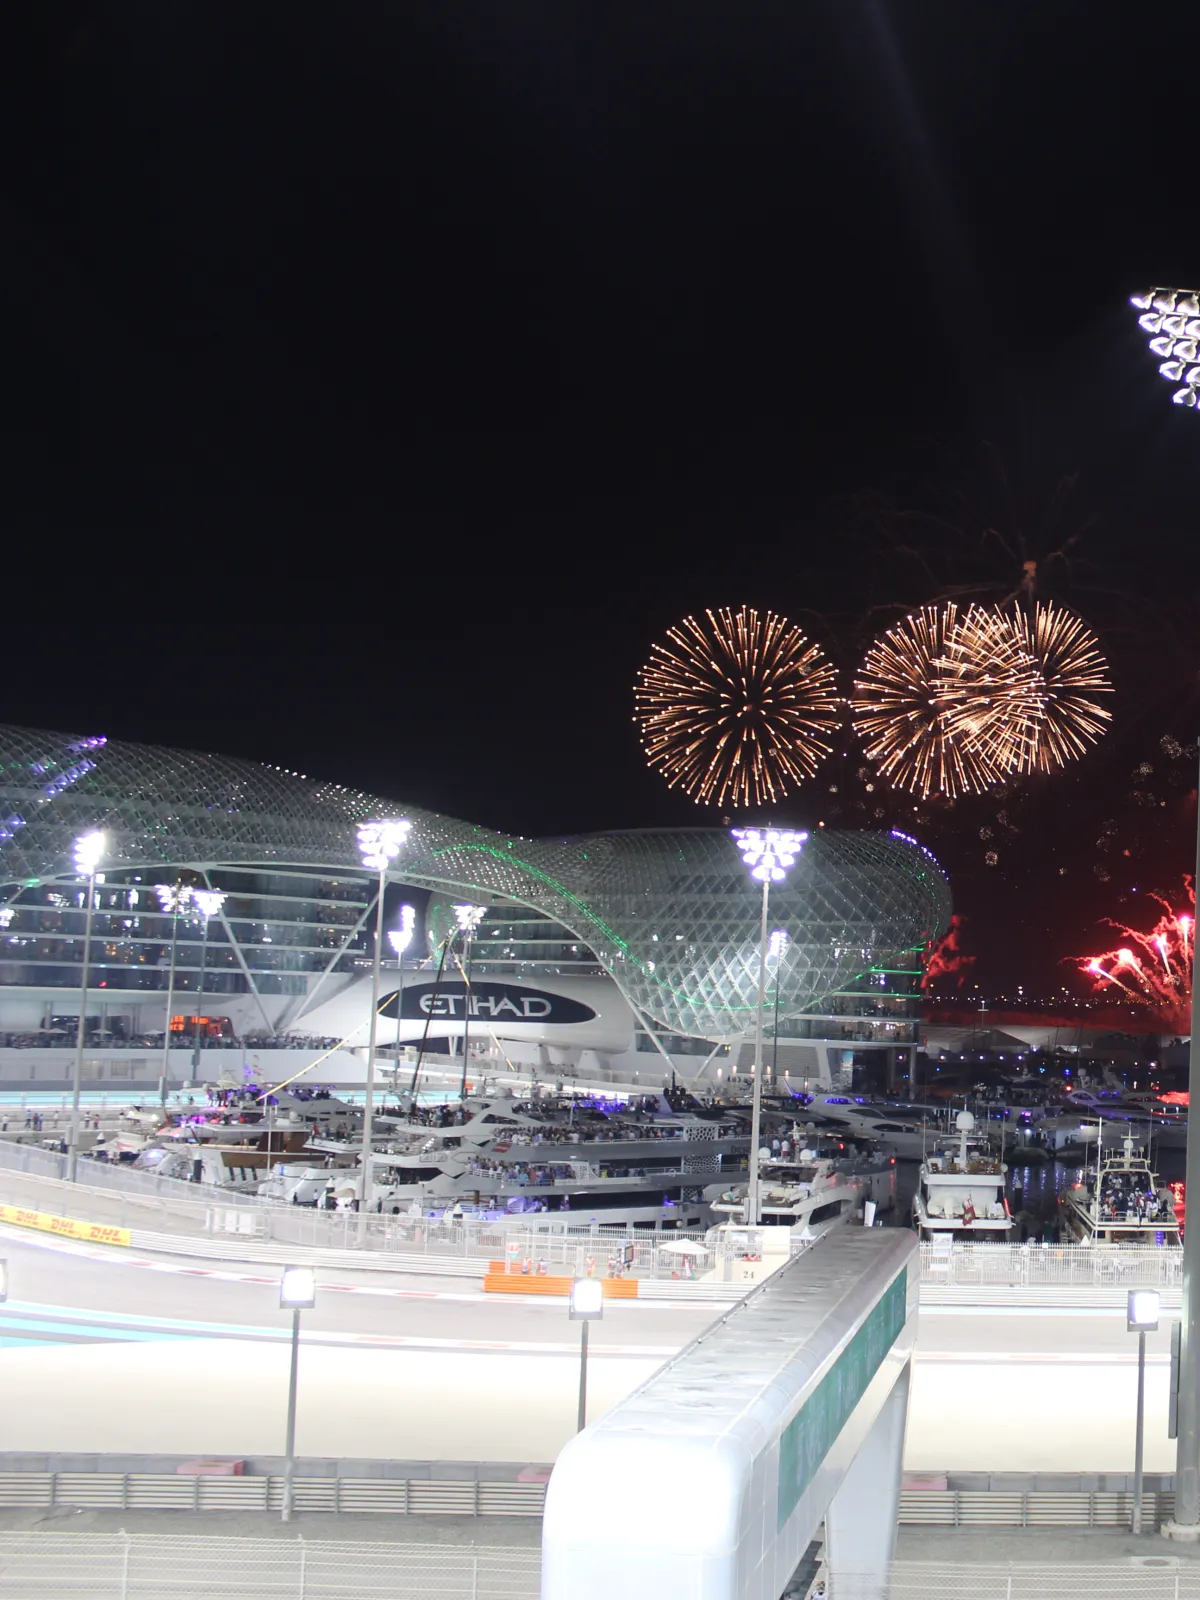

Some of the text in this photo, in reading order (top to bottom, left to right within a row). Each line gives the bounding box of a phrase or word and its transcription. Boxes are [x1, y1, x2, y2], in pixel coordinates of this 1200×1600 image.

[419, 993, 552, 1017] ETIHAD
[16, 1210, 39, 1226] DHL
[50, 1218, 75, 1234] DHL
[90, 1226, 121, 1242] DHL
